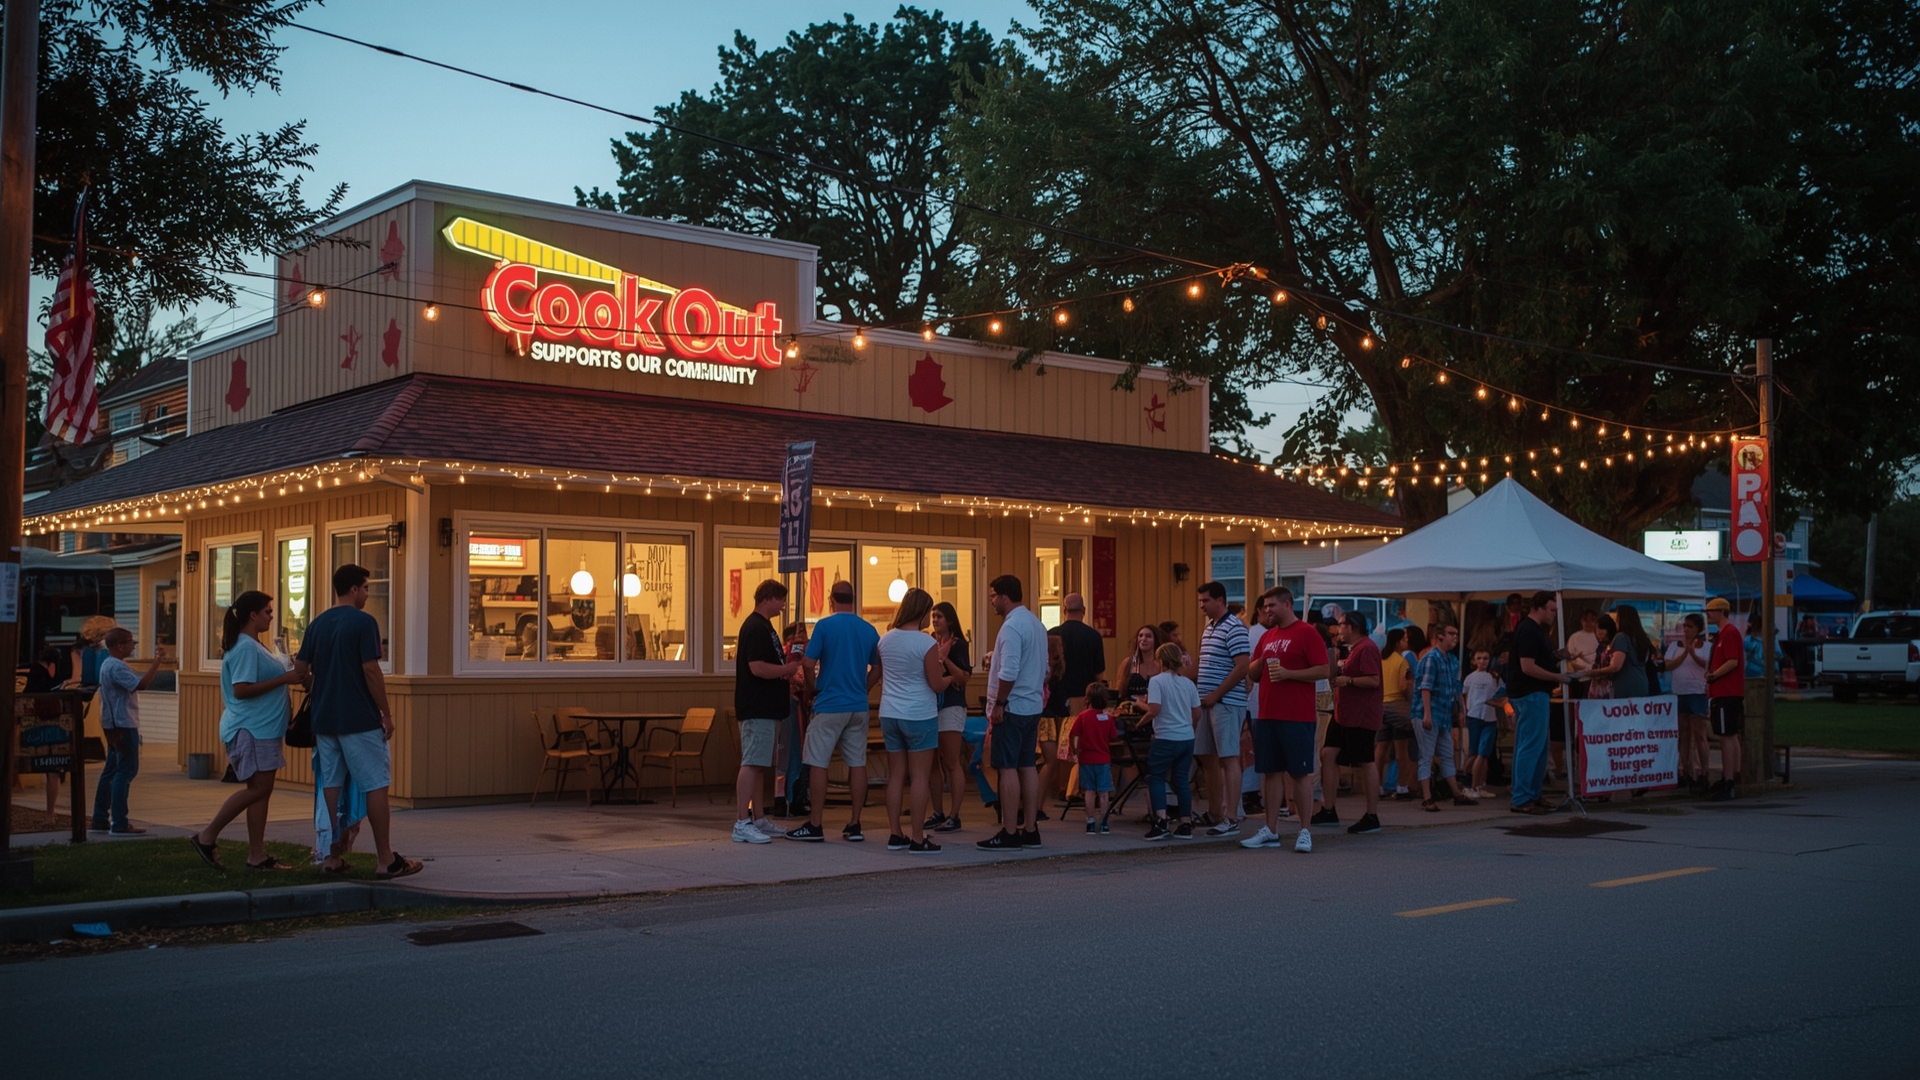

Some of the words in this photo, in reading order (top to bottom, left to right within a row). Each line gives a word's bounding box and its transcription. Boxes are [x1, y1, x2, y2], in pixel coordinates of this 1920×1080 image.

[482, 262, 666, 352] Cook
[667, 286, 783, 368] Out
[530, 340, 622, 371] SUPPORTS
[626, 352, 662, 375] OUR
[665, 357, 758, 386] COMMUNITY
[1610, 758, 1656, 773] burger
